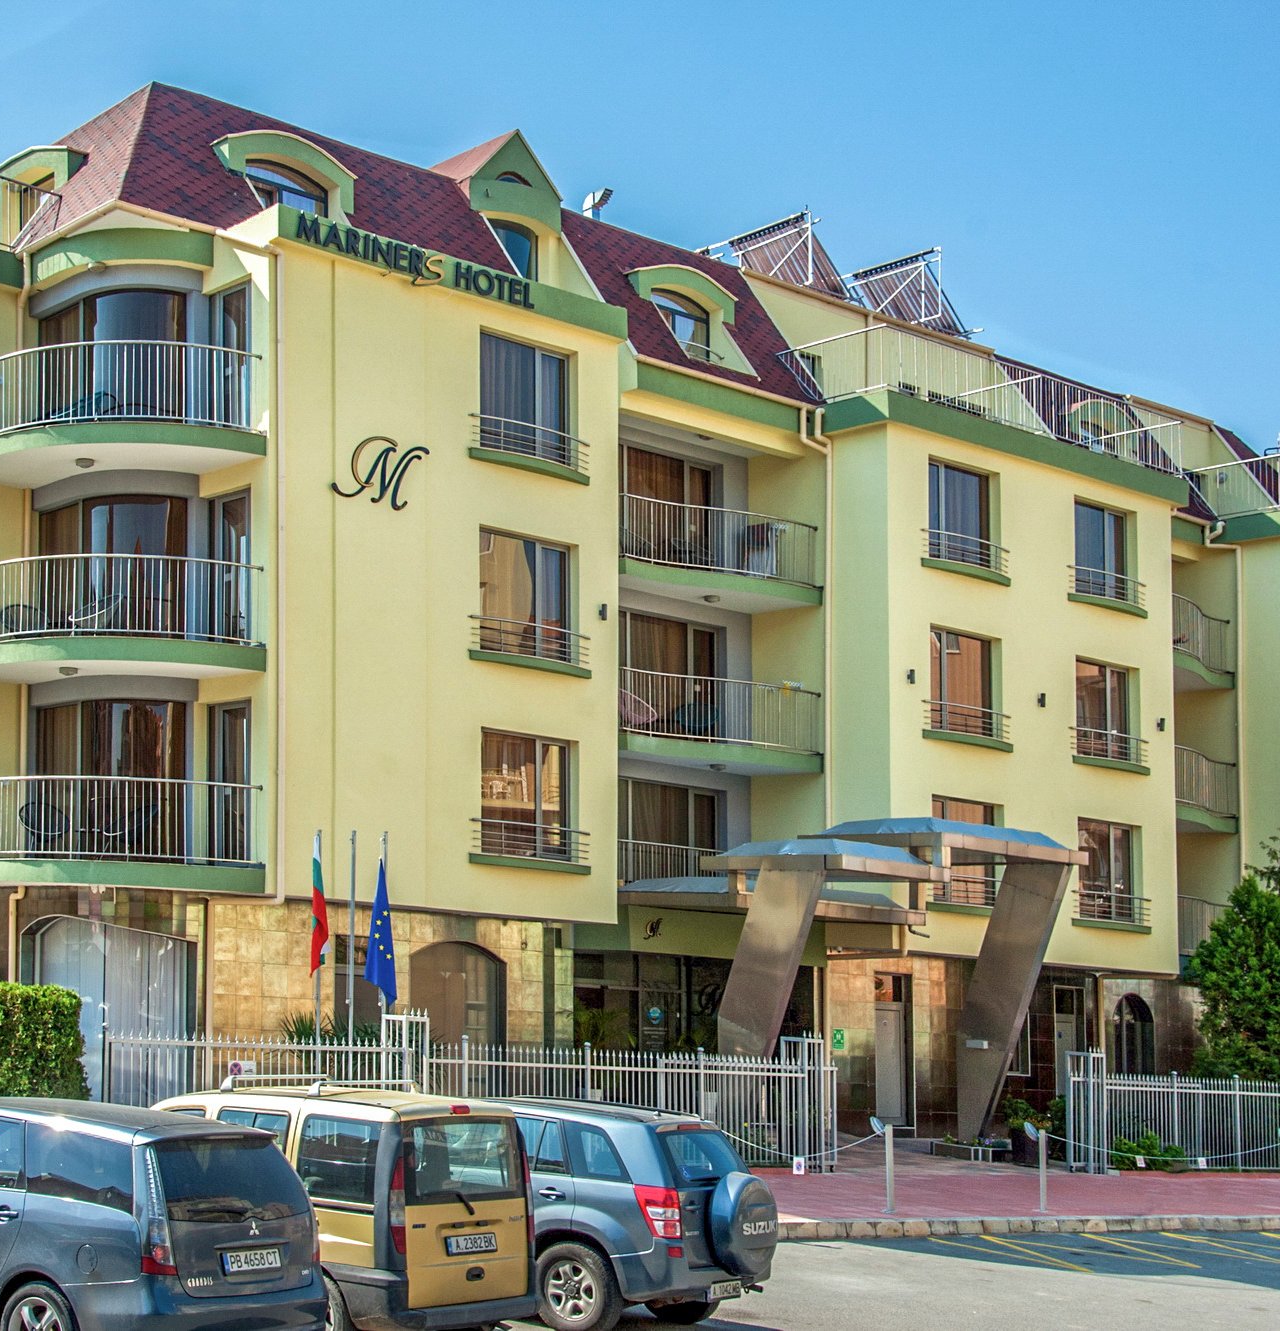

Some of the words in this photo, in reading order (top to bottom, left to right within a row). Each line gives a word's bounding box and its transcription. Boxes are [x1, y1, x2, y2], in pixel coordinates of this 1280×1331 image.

[296, 212, 444, 286] MARINER'S
[455, 262, 535, 309] HOTEL
[331, 436, 430, 511] M
[743, 1220, 778, 1235] SUZUKI
